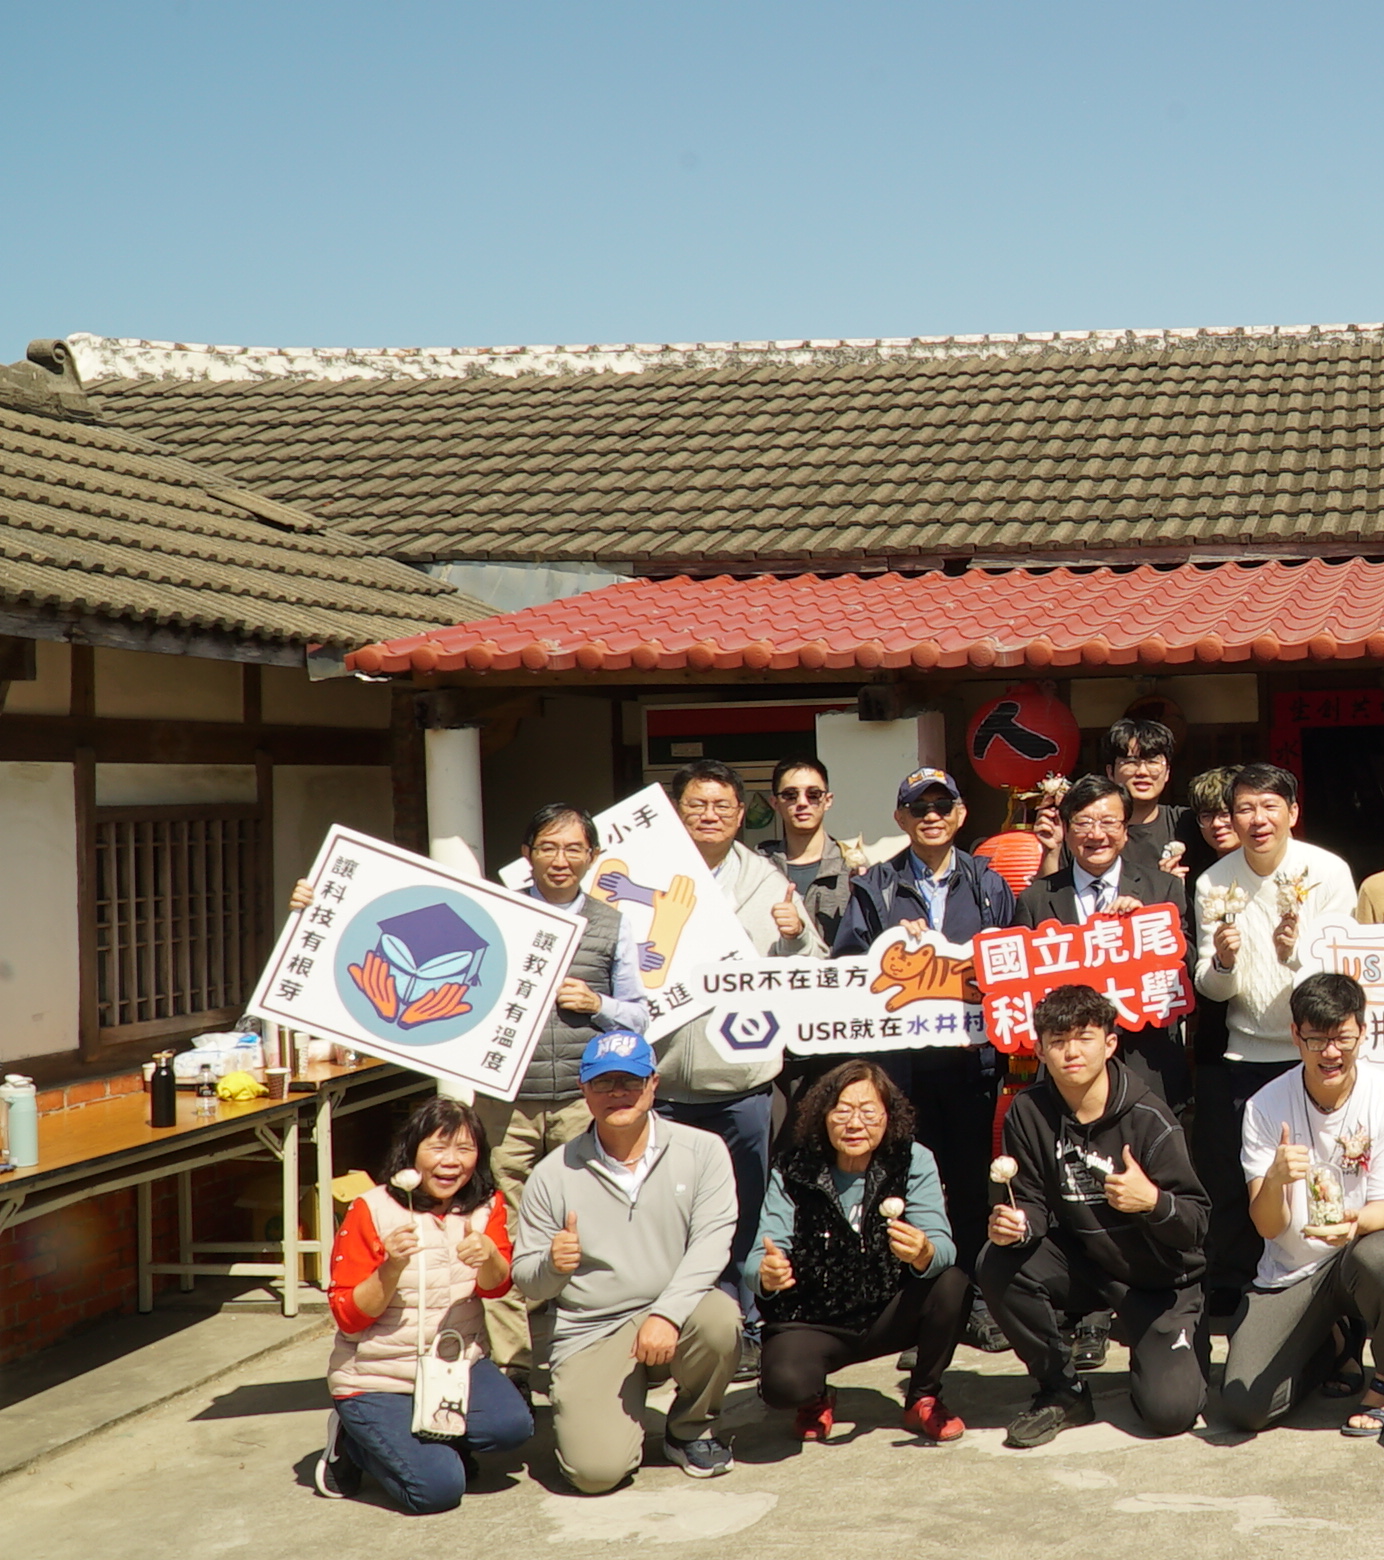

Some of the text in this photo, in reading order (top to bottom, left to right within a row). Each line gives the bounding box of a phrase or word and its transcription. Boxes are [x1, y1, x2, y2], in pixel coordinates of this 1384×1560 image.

[600, 803, 659, 856] 小手
[275, 855, 360, 1002] 讓科技有根芽
[979, 910, 1178, 985] 國立虎尾
[480, 929, 558, 1073] 讓教育有溫度
[703, 966, 869, 993] USR不在遠方
[991, 968, 1188, 1045] 科大學
[594, 1033, 638, 1060] NFU
[797, 1011, 984, 1042] USR就在水井村
